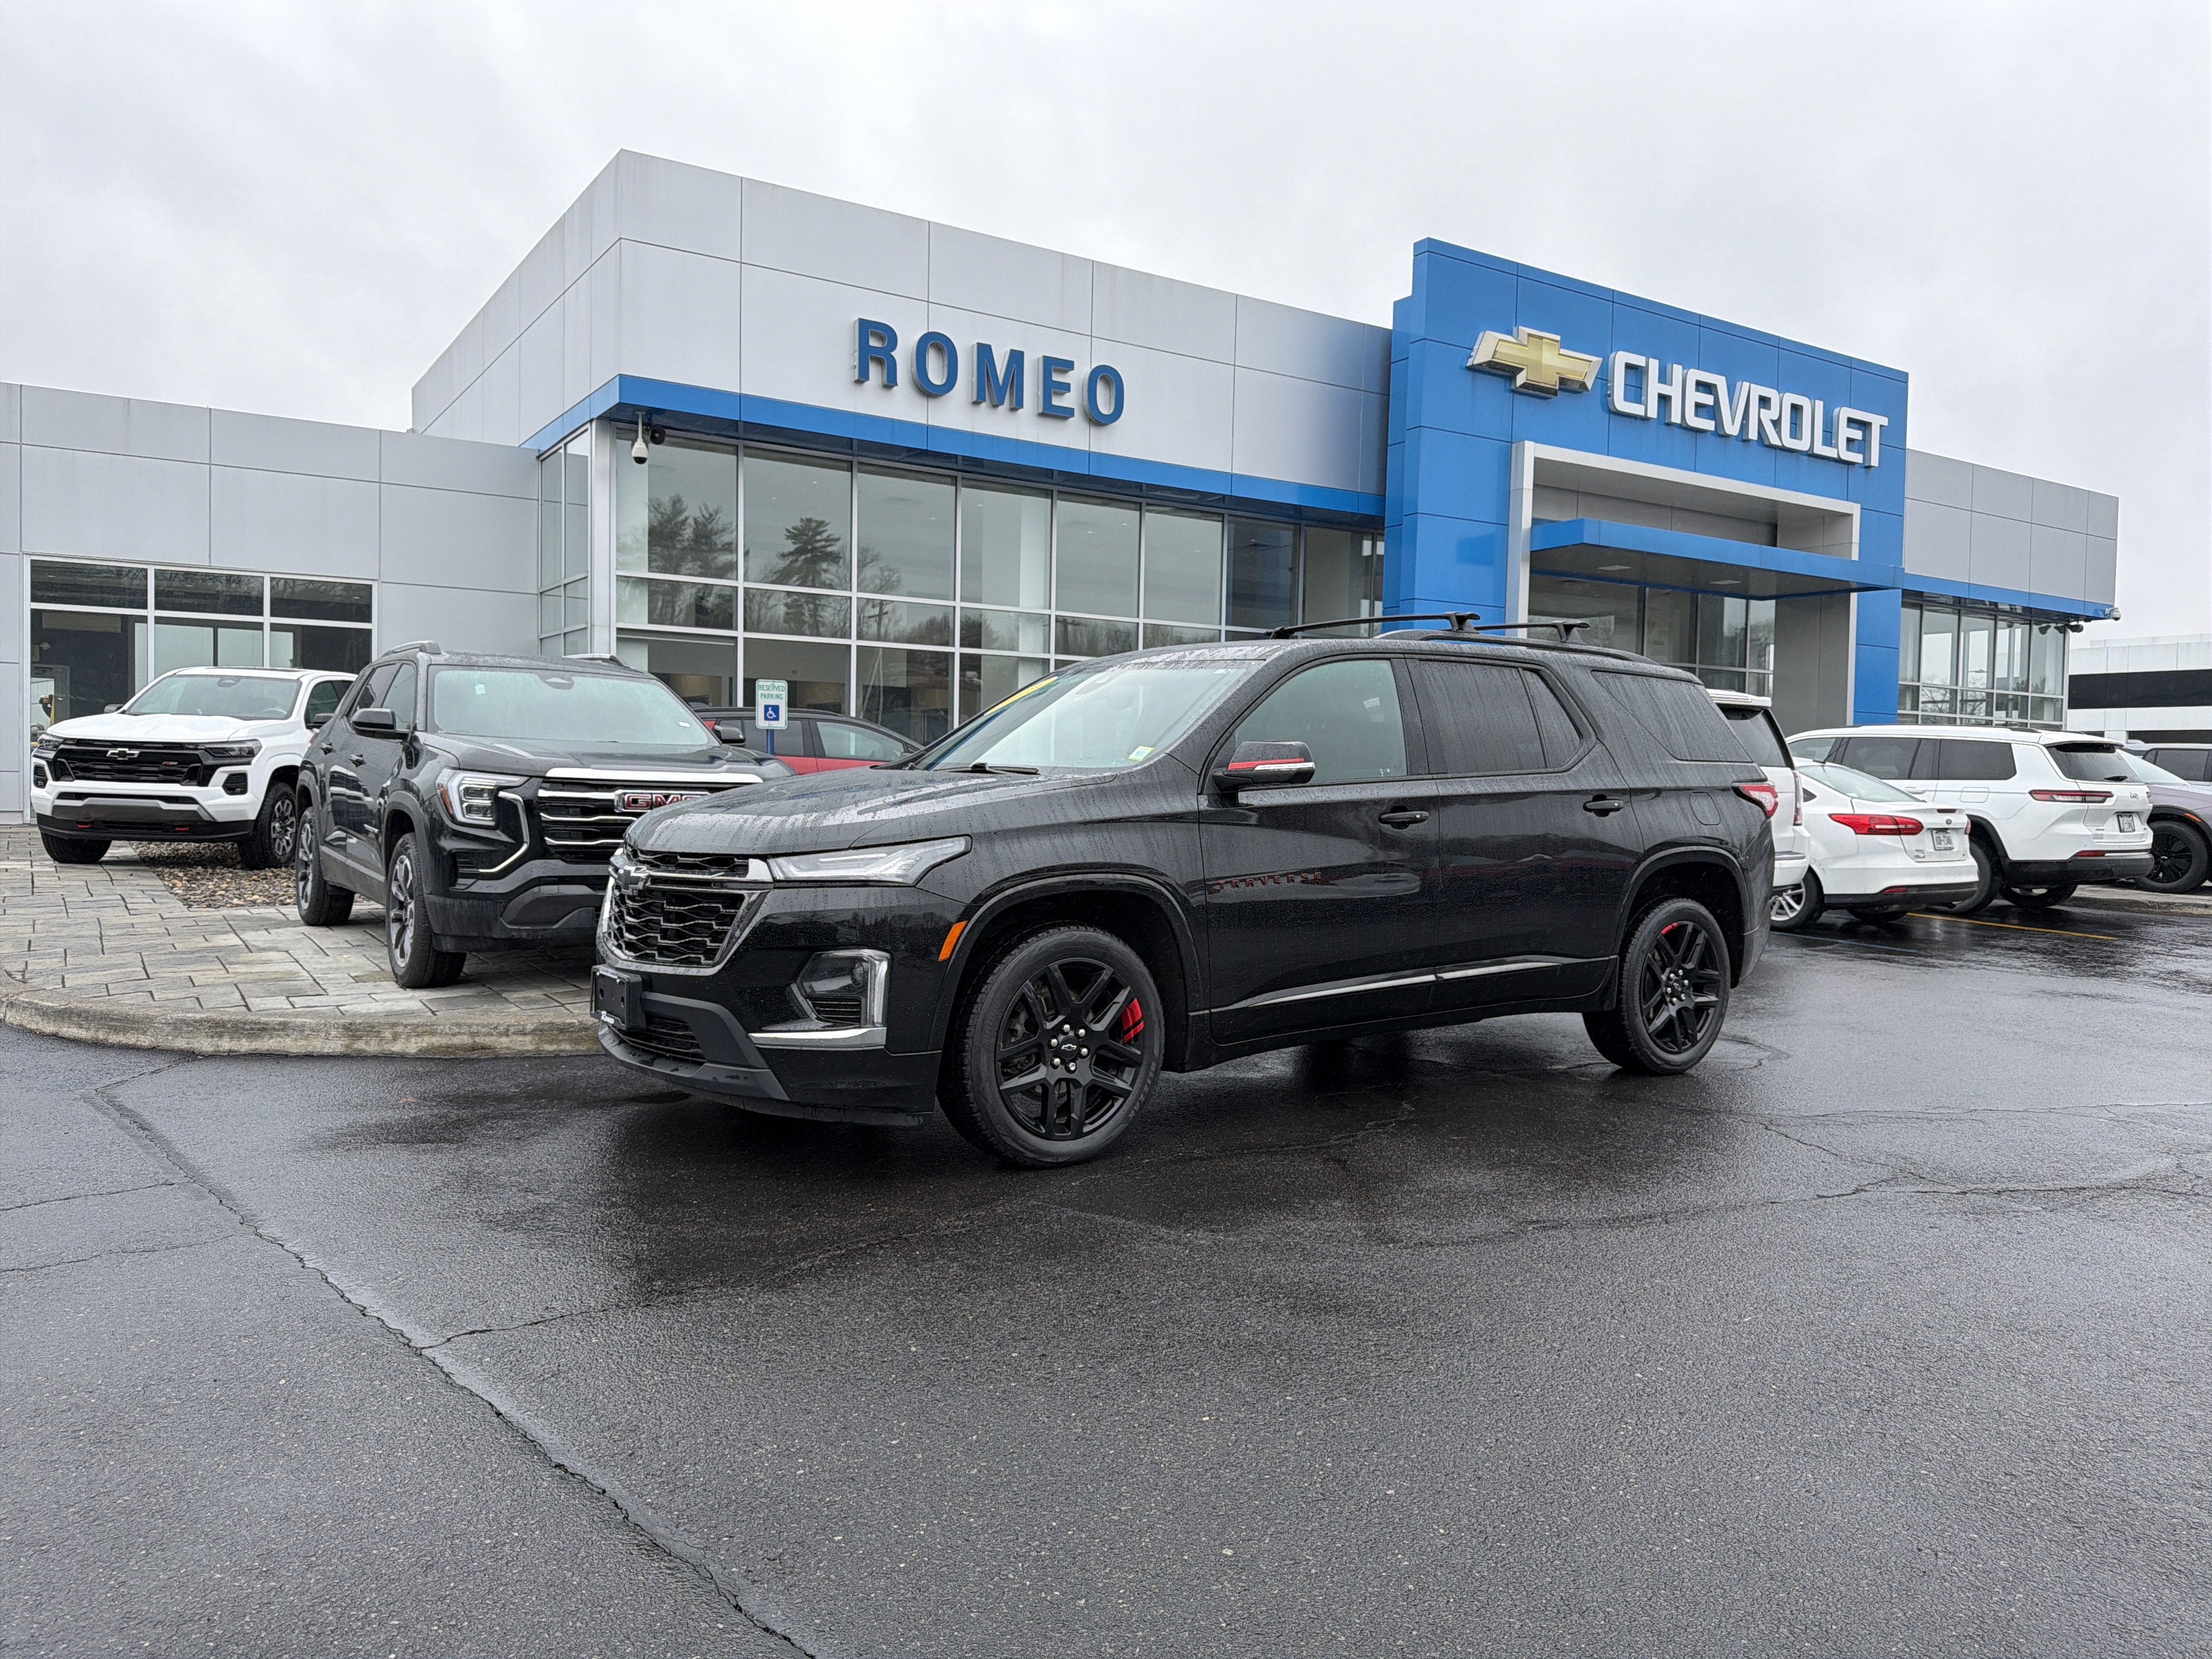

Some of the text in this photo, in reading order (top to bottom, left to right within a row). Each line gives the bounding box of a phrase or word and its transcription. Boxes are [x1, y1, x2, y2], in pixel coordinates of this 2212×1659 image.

[854, 318, 1124, 426] ROMEO
[1608, 351, 1889, 467] CHEVROLET
[624, 793, 701, 809] GM
[1218, 871, 1322, 889] TRAVERSE
